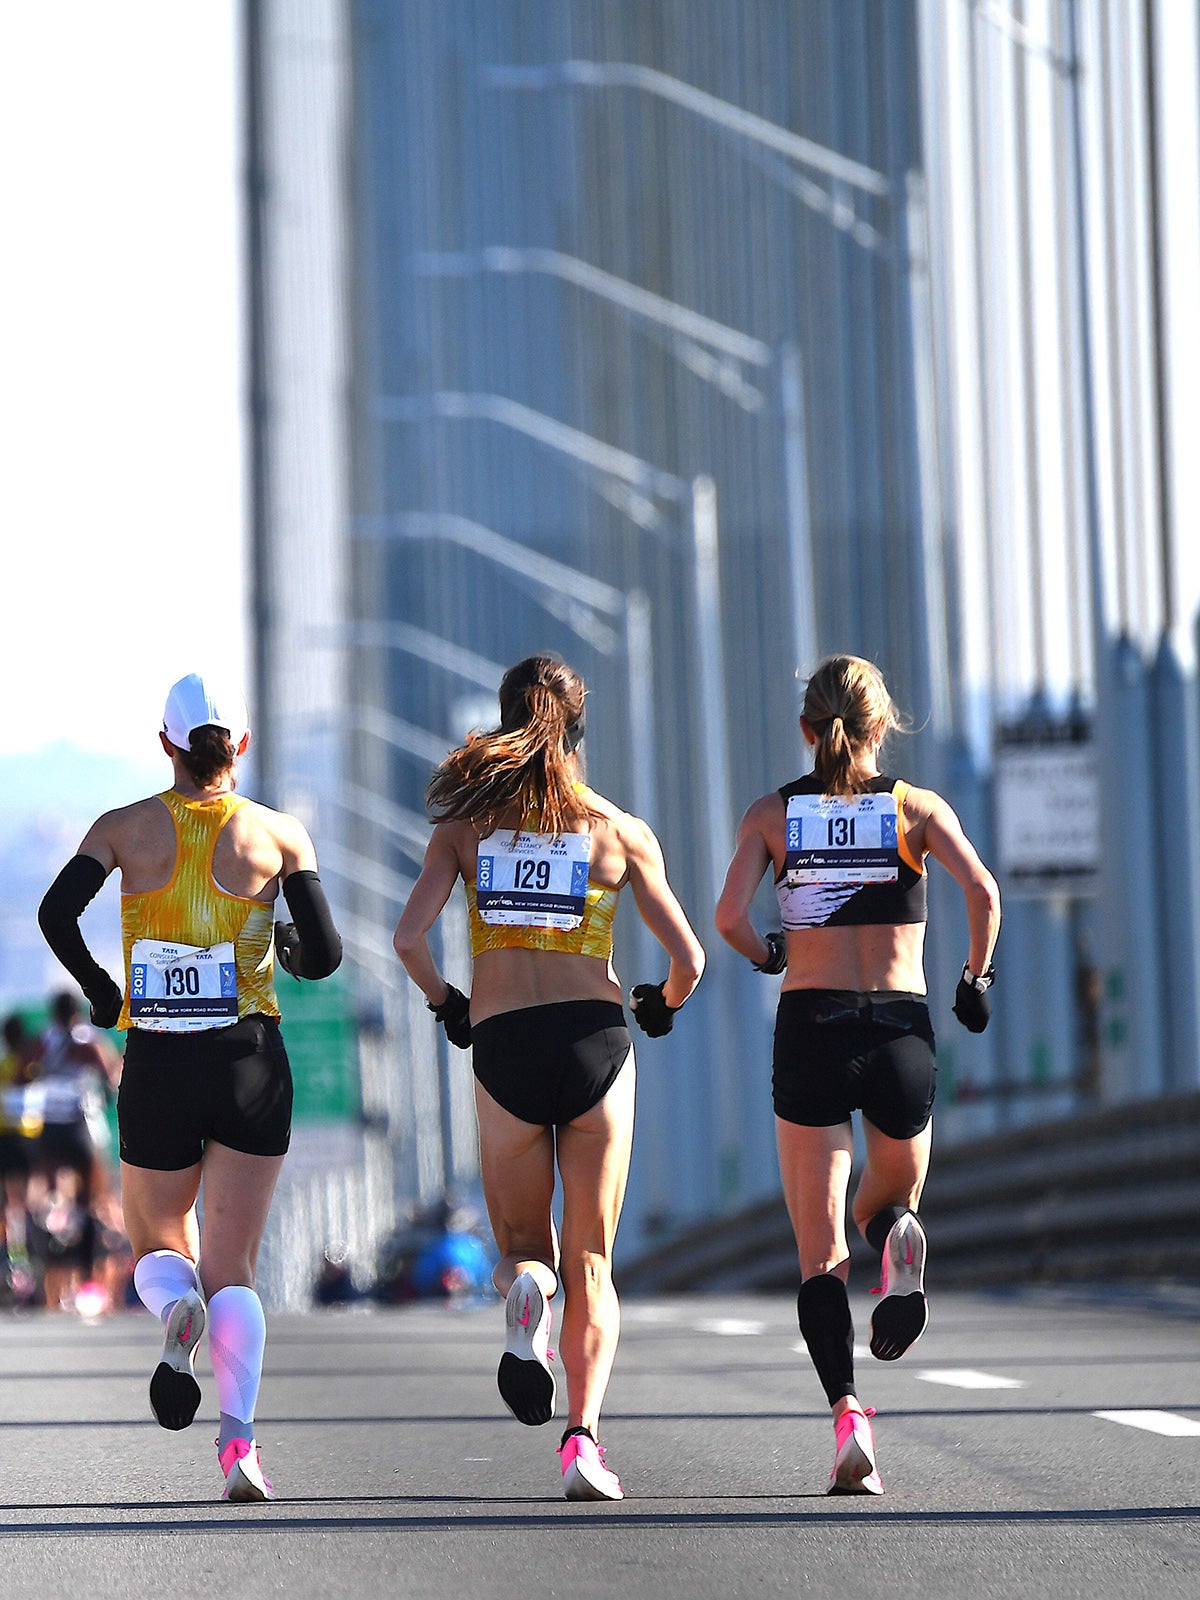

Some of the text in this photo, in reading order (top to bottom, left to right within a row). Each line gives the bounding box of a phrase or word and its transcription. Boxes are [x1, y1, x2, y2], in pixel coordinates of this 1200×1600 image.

[790, 821, 799, 847] 2019
[828, 817, 855, 846] 131
[480, 859, 490, 888] 2019
[514, 860, 550, 890] 129
[134, 967, 144, 995] 2019
[165, 967, 200, 996] 130
